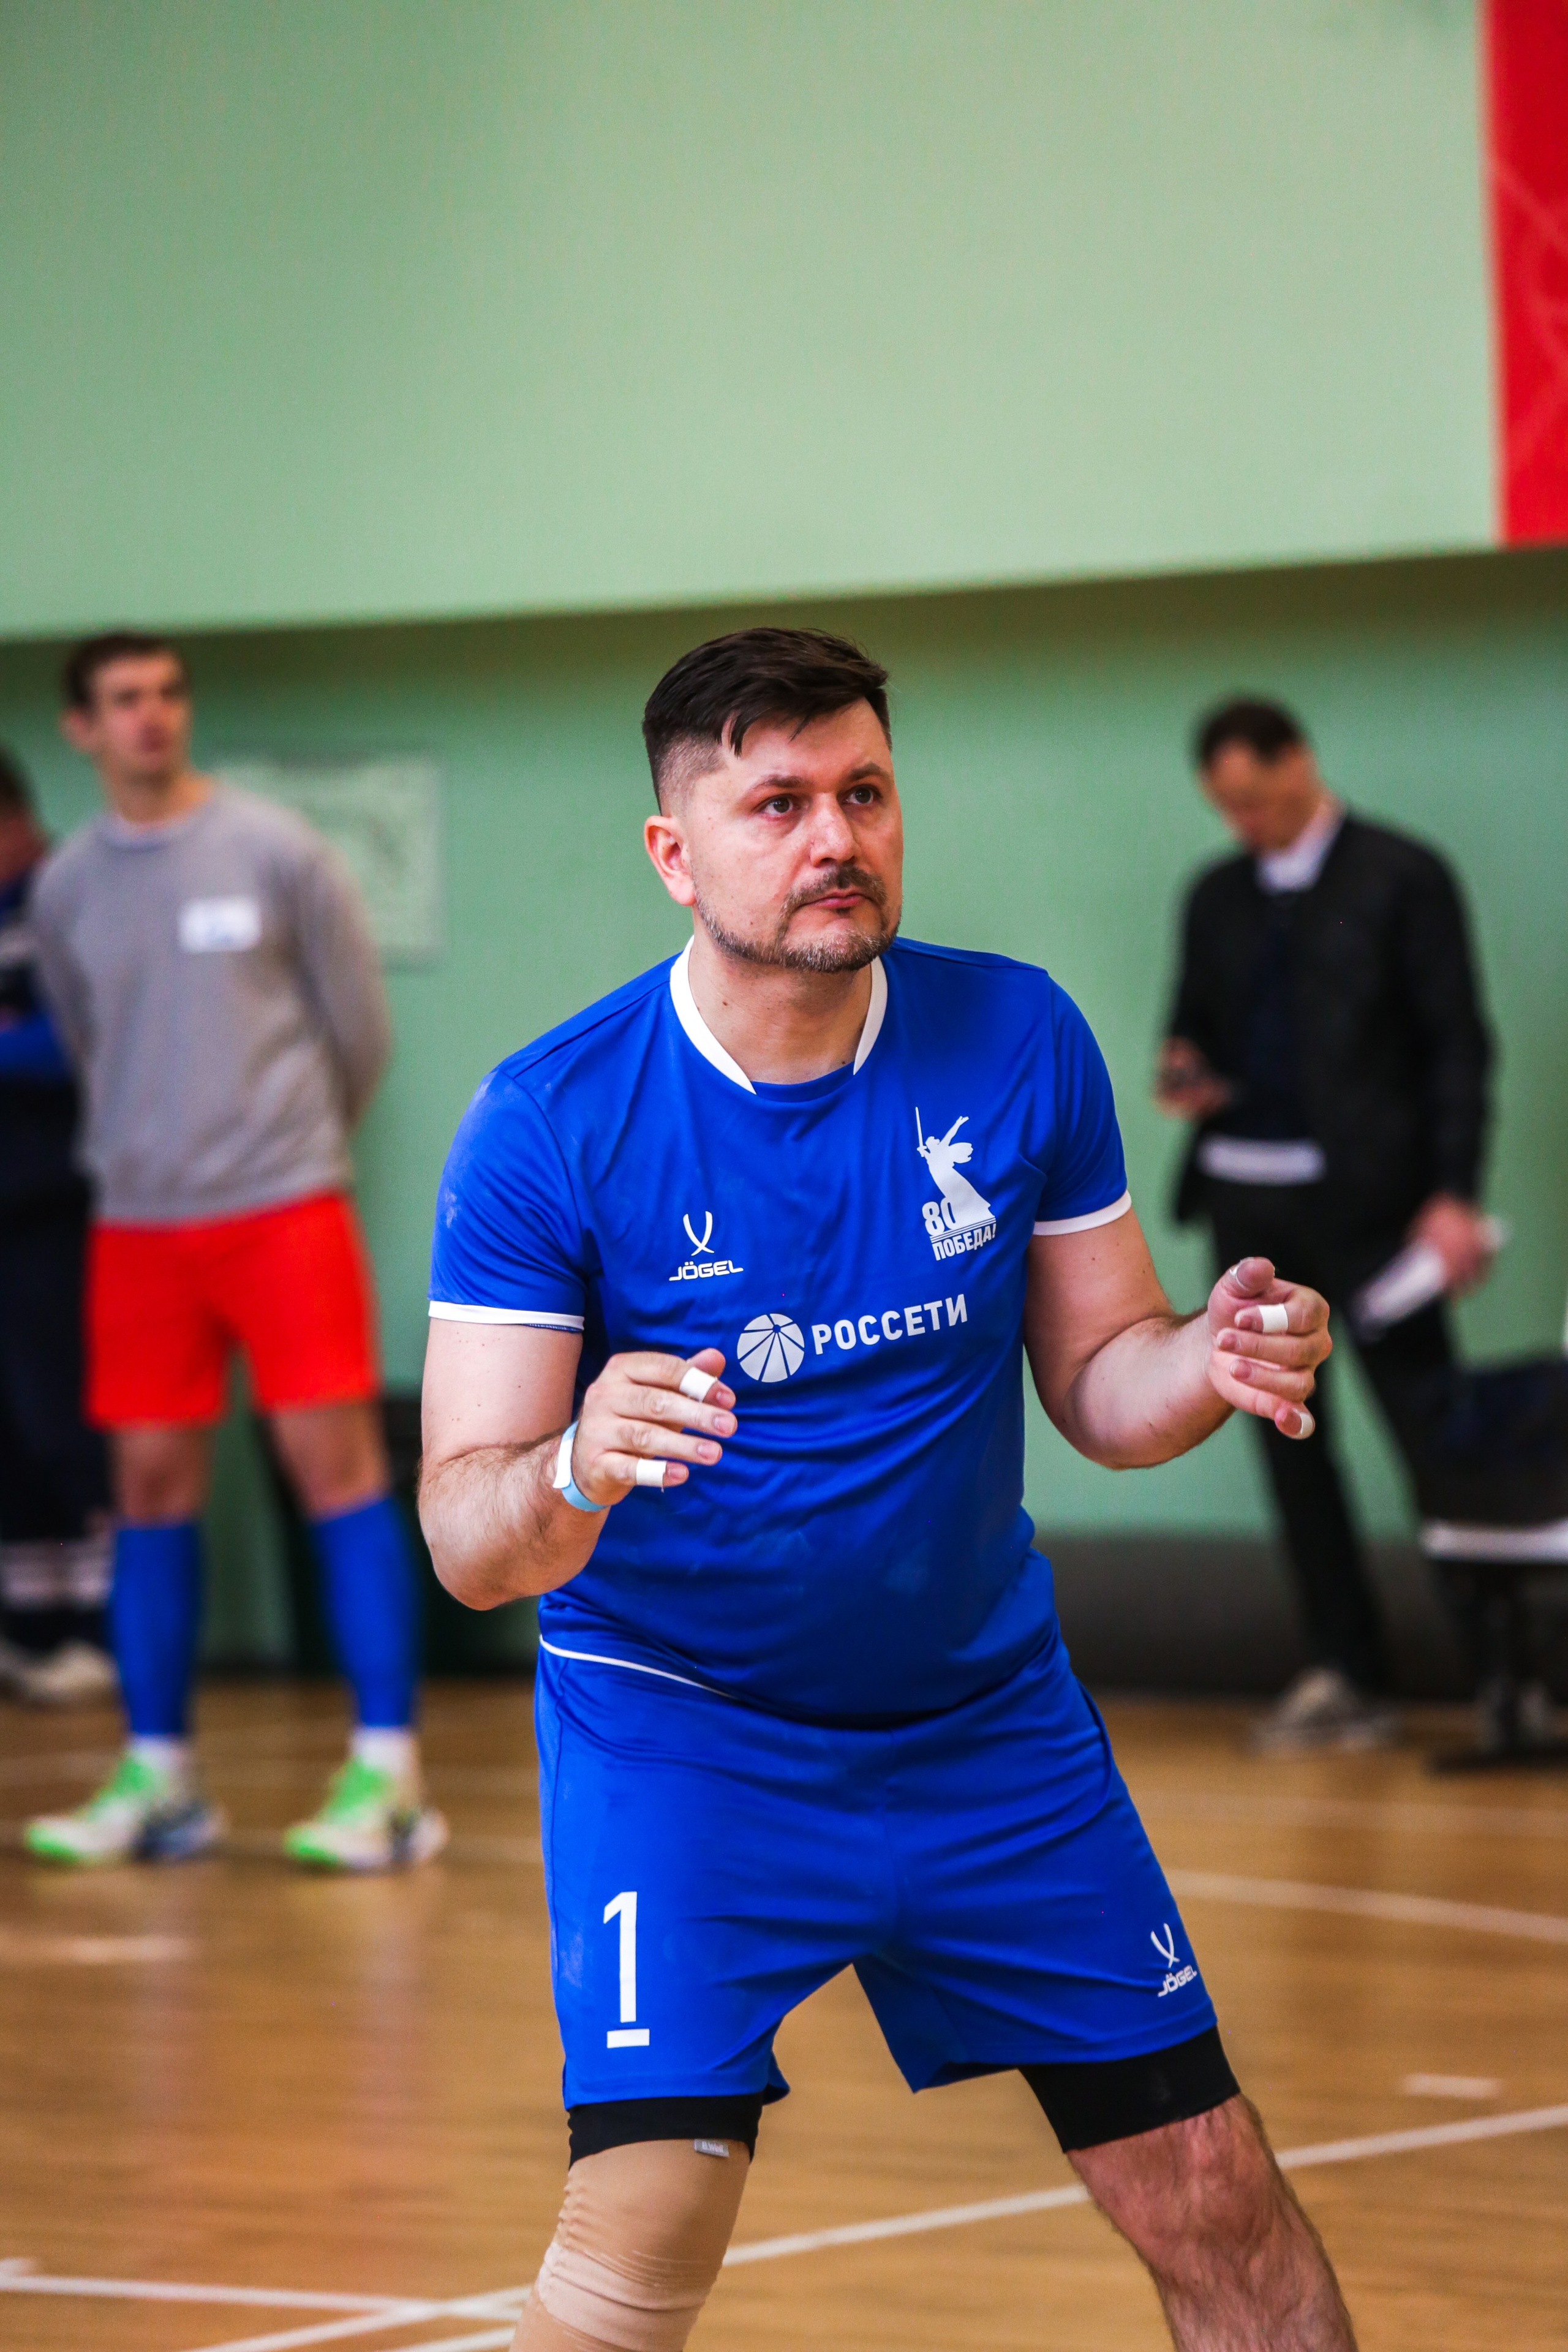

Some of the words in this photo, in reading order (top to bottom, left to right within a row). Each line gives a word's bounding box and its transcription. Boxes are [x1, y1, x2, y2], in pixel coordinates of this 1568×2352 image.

[922, 1196, 959, 1236] 80
[932, 1223, 997, 1261] ПОБЕДА!
[669, 1260, 744, 1281] JÖGEL
[812, 1294, 968, 1355] РОССЕТИ
[603, 1891, 638, 2023] 1
[1158, 1964, 1197, 1997] JÖGEL
